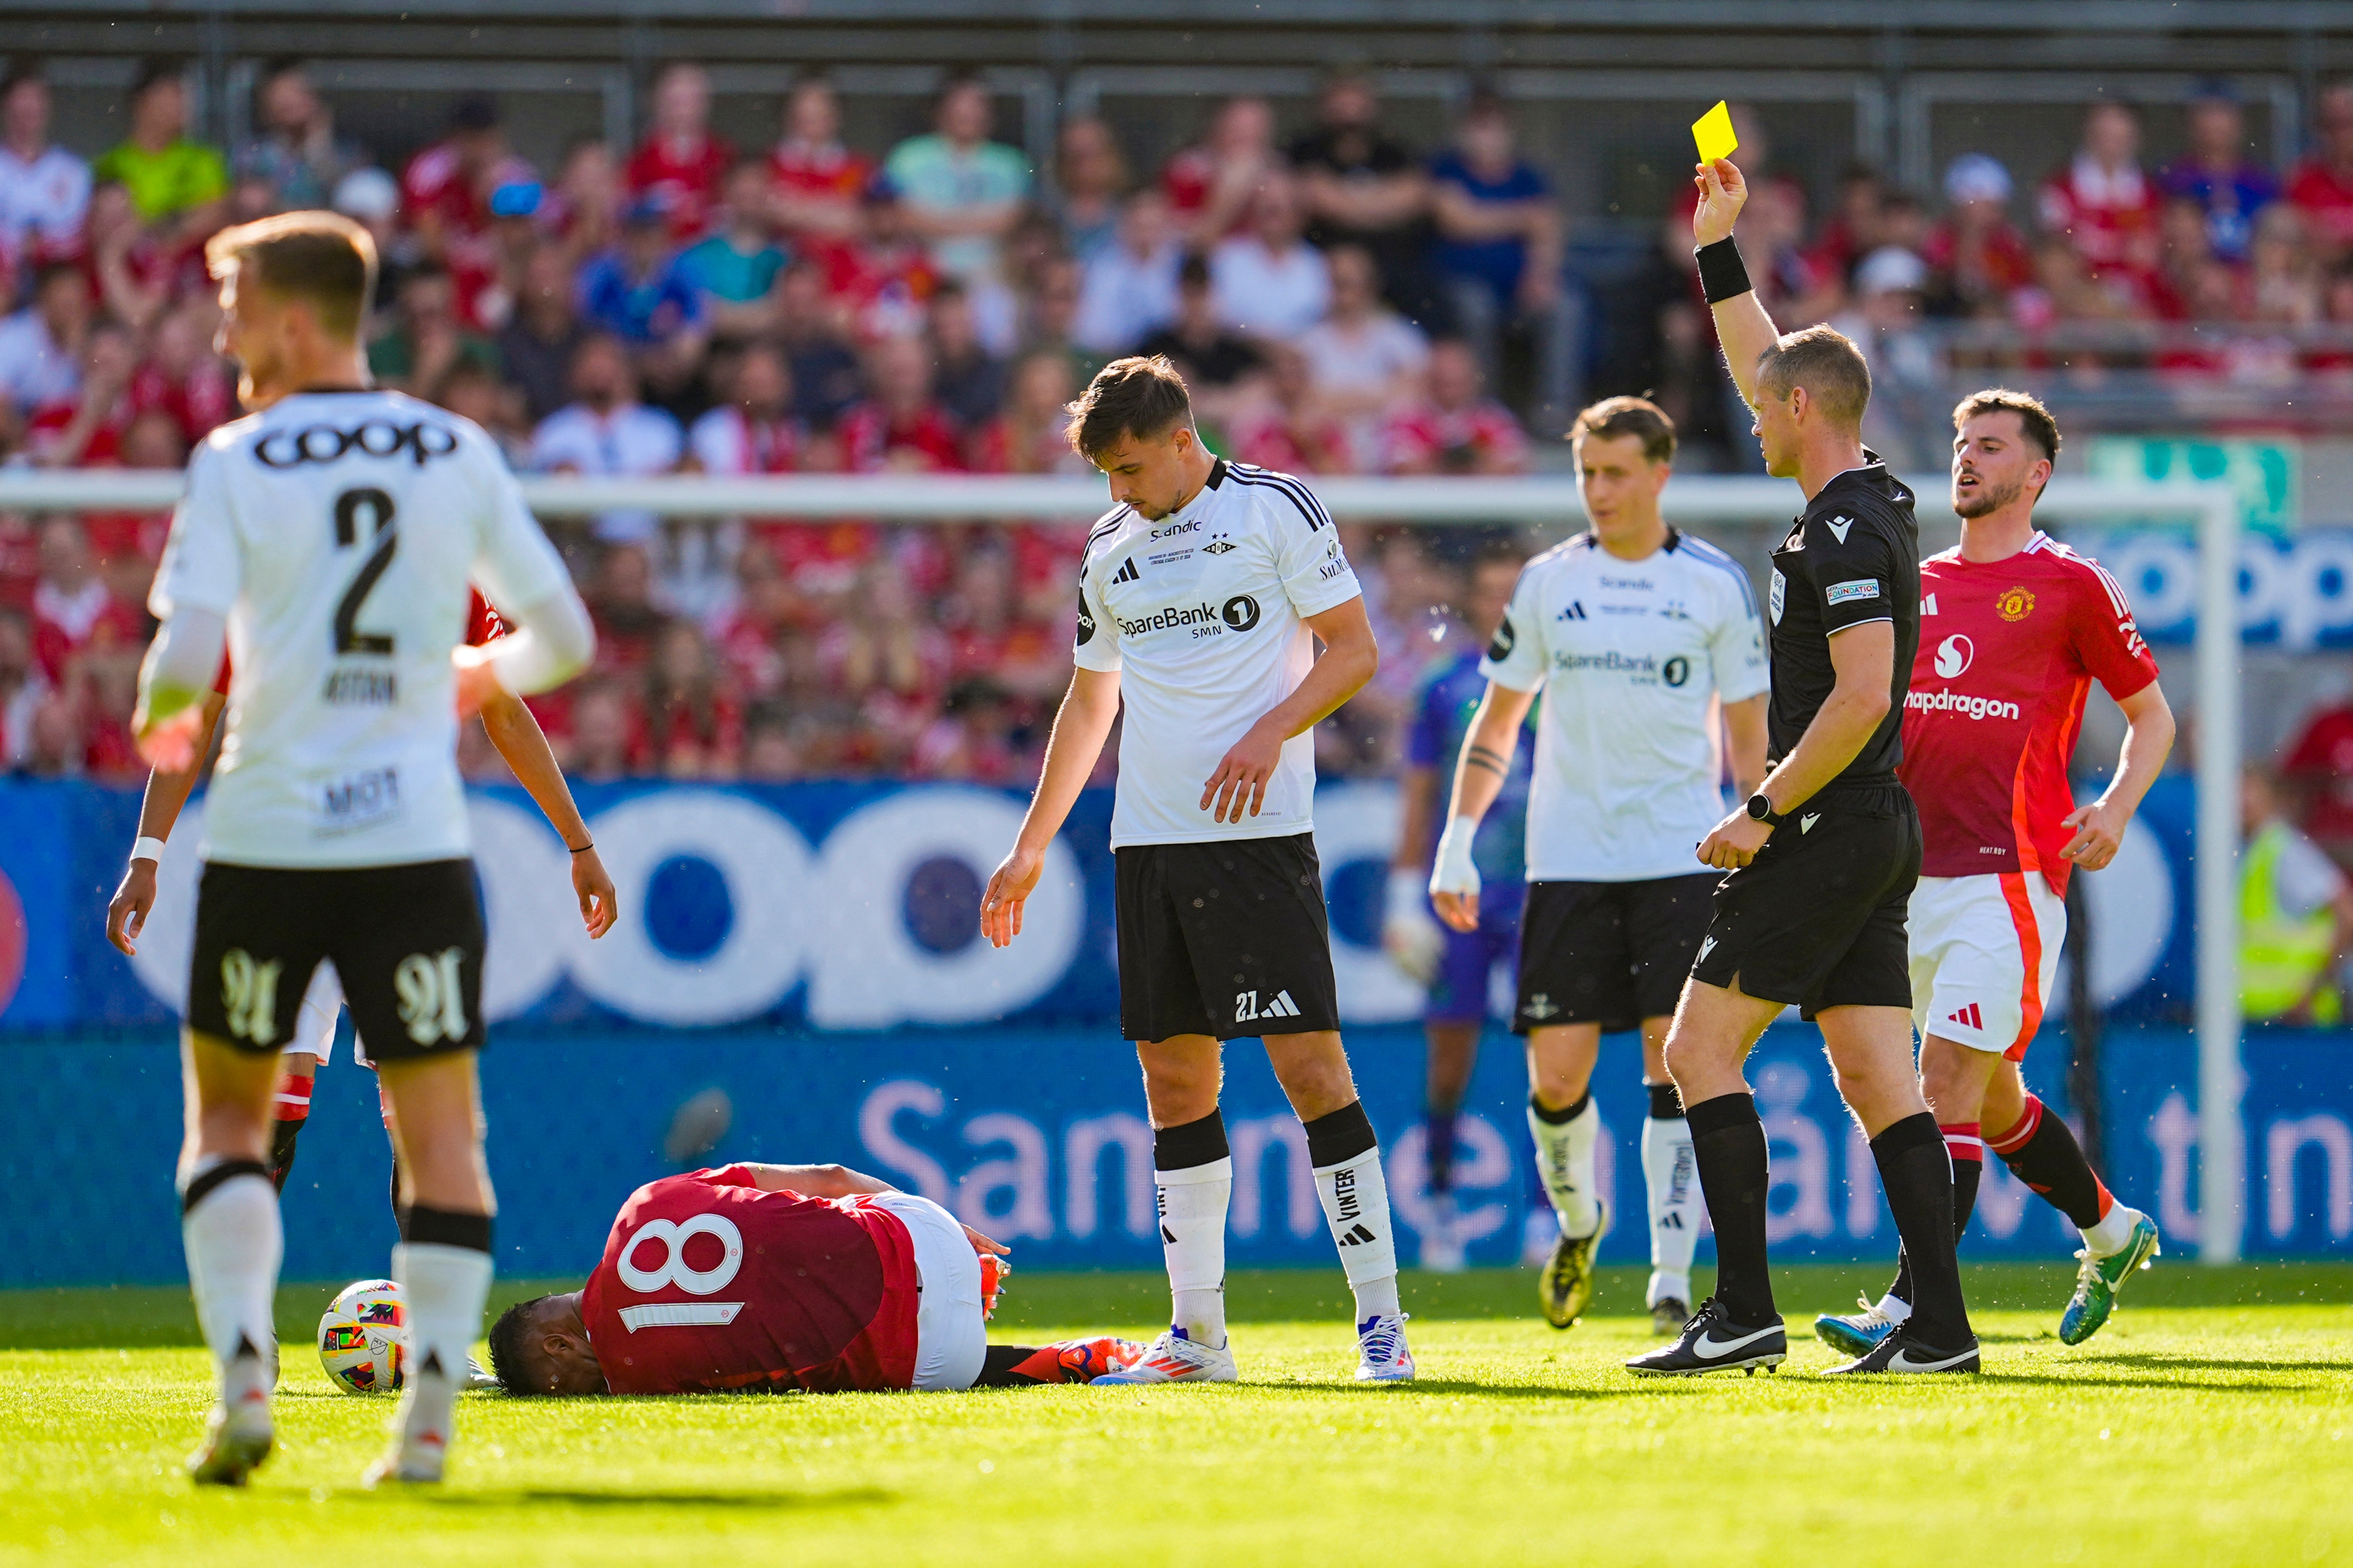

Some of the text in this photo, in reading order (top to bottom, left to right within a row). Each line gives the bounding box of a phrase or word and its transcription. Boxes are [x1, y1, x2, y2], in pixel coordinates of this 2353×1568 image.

[255, 420, 457, 469] coop
[334, 487, 396, 654] 2
[1828, 585, 1877, 599] FOUNDATION
[1117, 602, 1218, 638] SpareBank
[1192, 625, 1222, 639] SMN
[1555, 651, 1657, 671] SpareBank
[1903, 688, 2019, 720] napdragon
[1236, 990, 1258, 1023] 21
[1334, 1168, 1361, 1222] VINTER
[617, 1213, 745, 1334] 18
